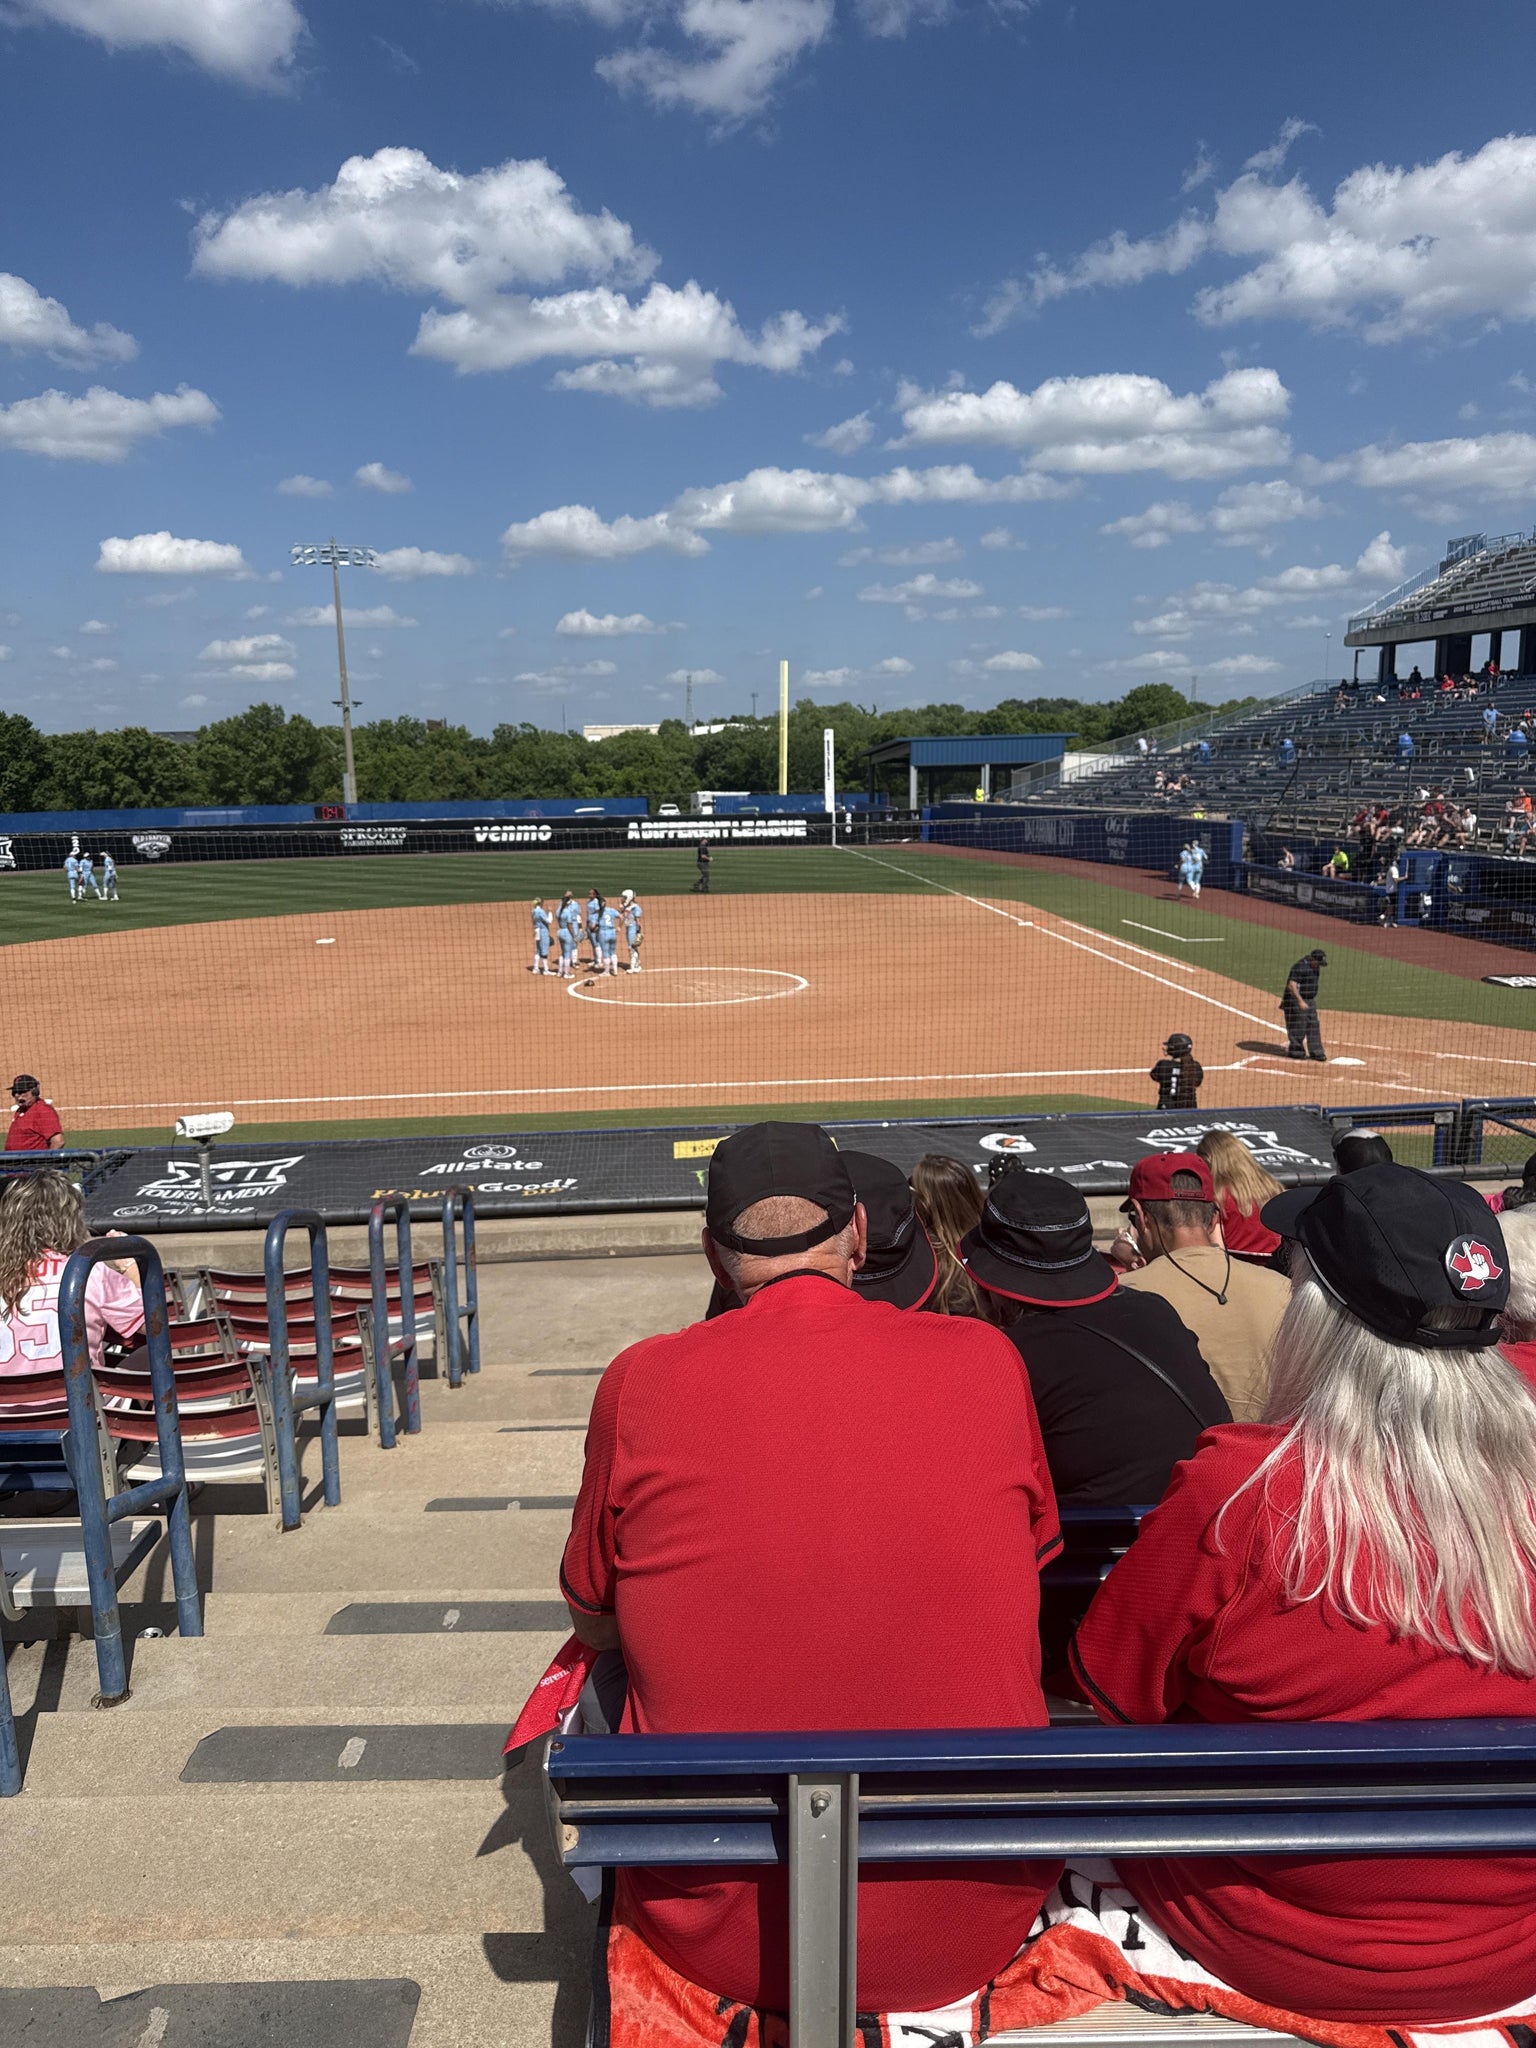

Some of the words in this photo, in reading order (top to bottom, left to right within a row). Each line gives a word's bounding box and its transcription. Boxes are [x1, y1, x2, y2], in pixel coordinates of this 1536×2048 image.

[340, 827, 407, 840] SPROUTS
[474, 825, 552, 842] venmo
[628, 822, 641, 839] A
[641, 821, 731, 838] DIFFERENT
[731, 820, 807, 837] LEAGUE
[605, 914, 611, 926] 2
[1147, 1122, 1260, 1138] Allstate
[418, 1158, 544, 1176] Allstate
[136, 1184, 287, 1201] TOURNAMENT
[477, 1177, 579, 1193] Good!
